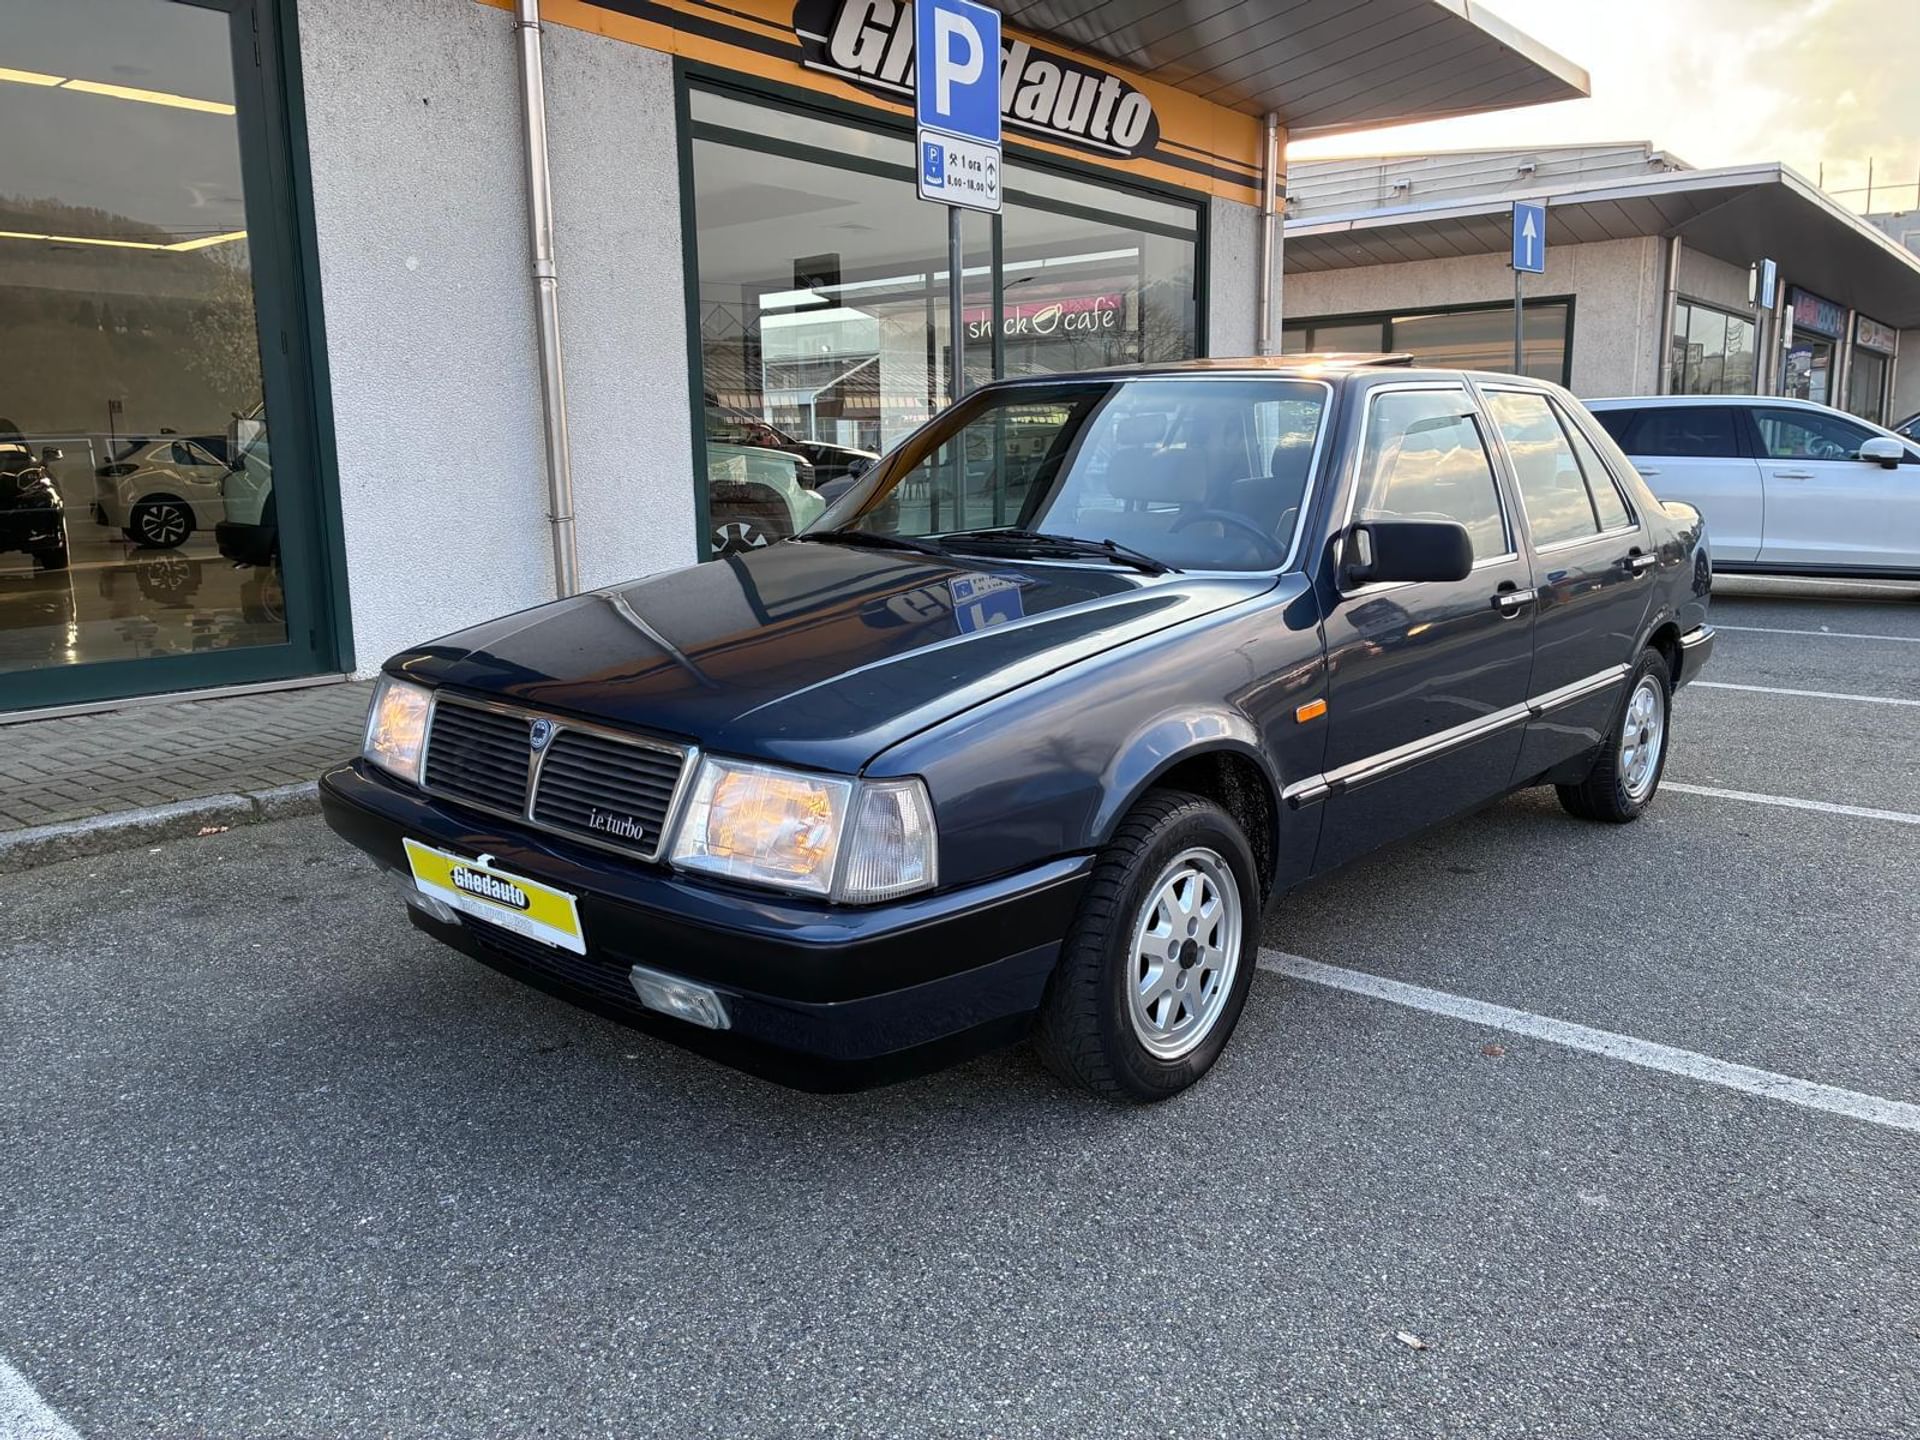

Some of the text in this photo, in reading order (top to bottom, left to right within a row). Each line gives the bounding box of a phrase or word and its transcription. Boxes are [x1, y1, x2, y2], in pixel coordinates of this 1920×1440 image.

[831, 0, 1152, 148] Ghdauto
[934, 7, 984, 116] P
[930, 148, 937, 160] P
[962, 154, 982, 172] 1 ora
[969, 305, 1028, 339] shck
[453, 866, 527, 908] Ghedauto
